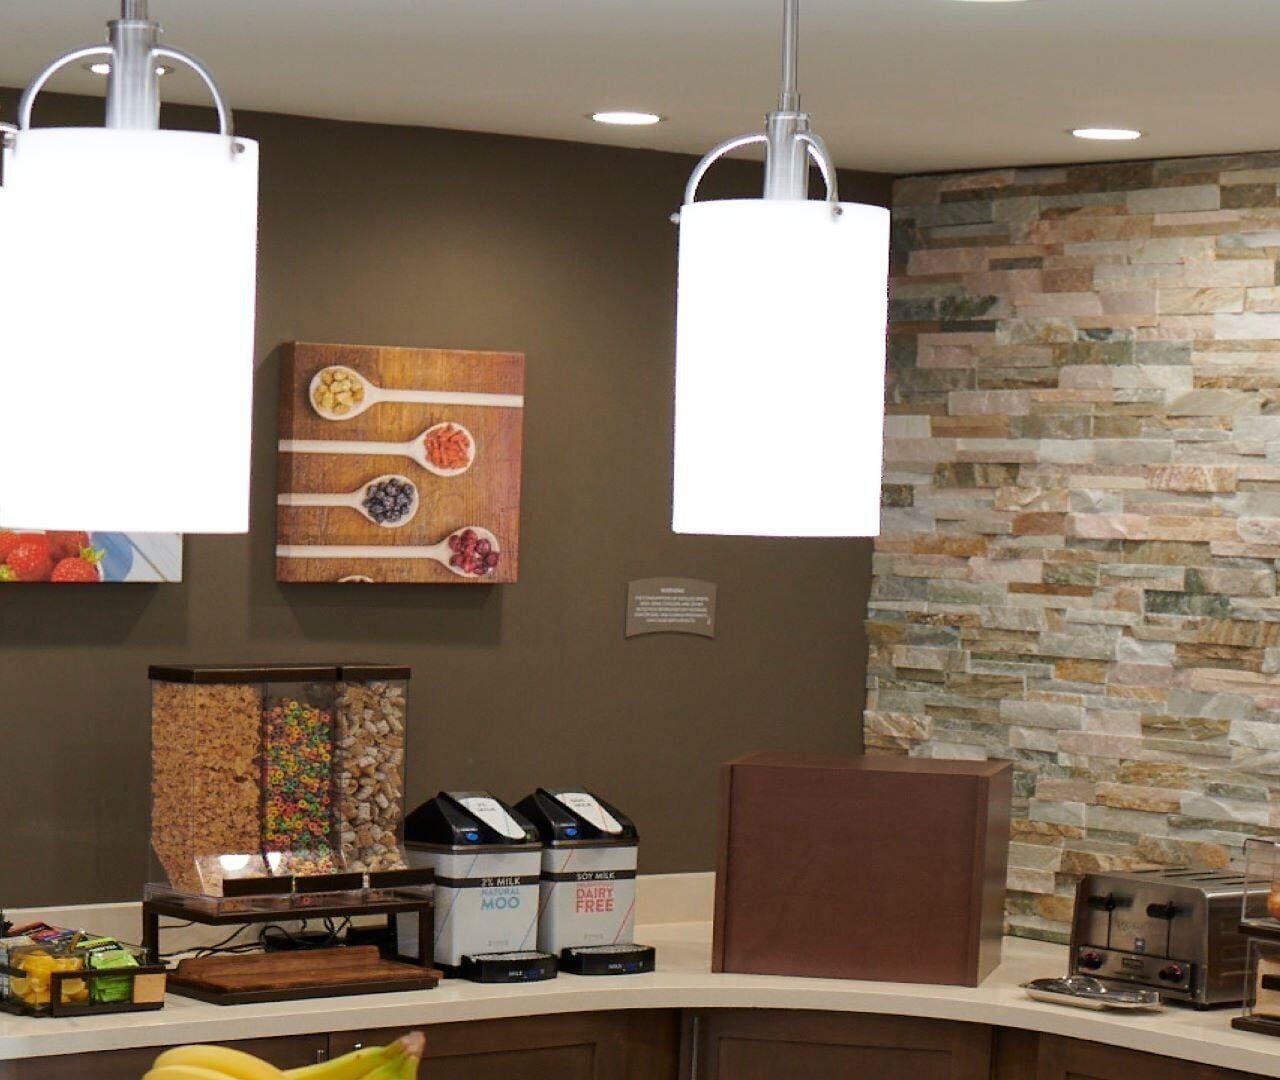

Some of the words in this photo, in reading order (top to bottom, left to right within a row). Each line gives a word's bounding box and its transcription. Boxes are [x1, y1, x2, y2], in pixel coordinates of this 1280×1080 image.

[496, 876, 520, 887] MILK
[576, 872, 594, 881] SOY
[595, 871, 616, 880] MILK
[481, 888, 520, 897] NATURAL
[576, 887, 614, 899] DAIRY
[480, 896, 520, 911] MOO
[576, 899, 614, 913] FREE
